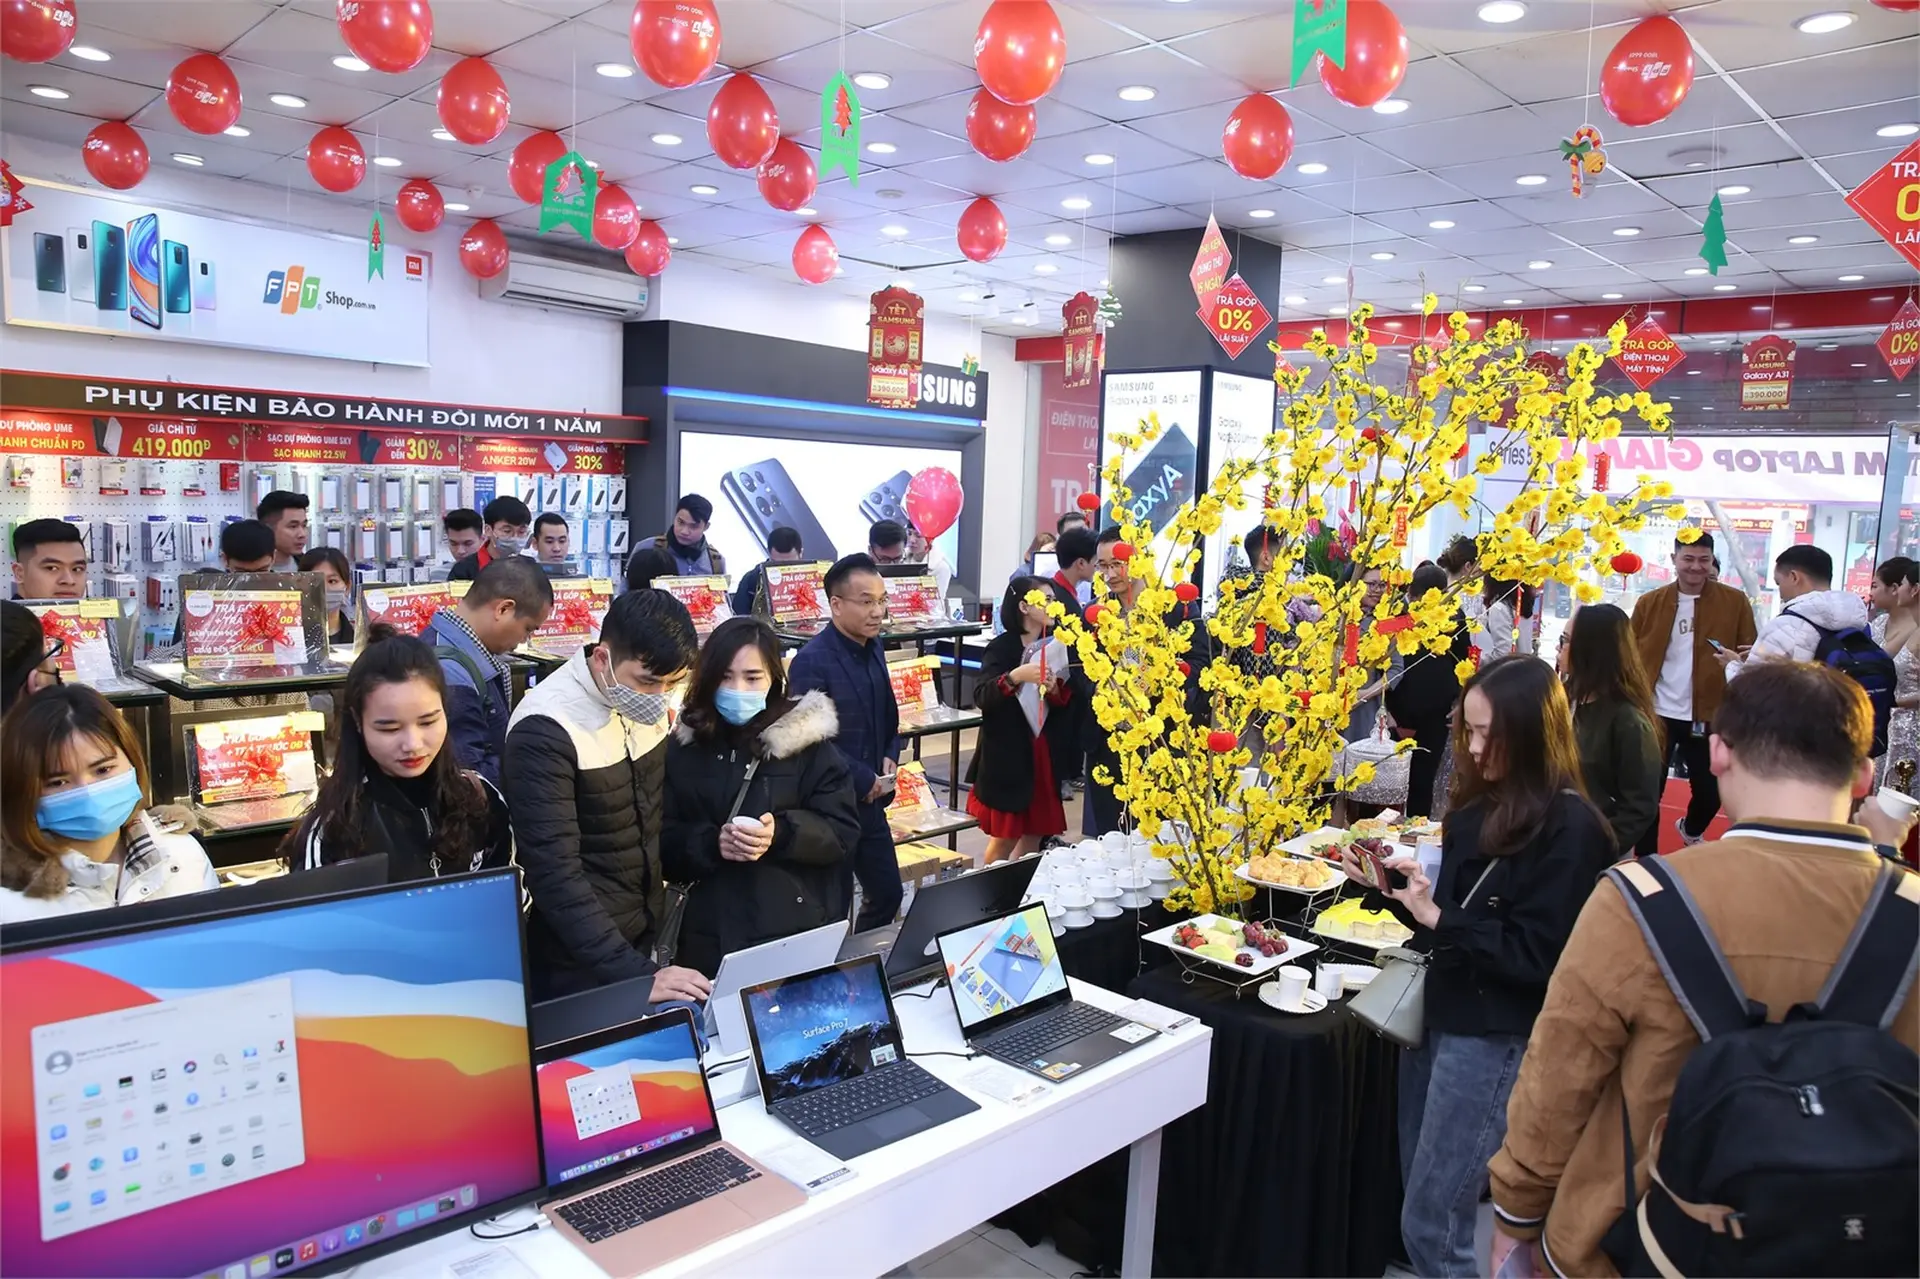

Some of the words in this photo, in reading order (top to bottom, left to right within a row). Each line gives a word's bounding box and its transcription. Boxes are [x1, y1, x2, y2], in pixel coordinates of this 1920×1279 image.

[1216, 293, 1234, 305] TRẢ
[1235, 294, 1257, 307] GÓP
[888, 304, 906, 315] TẾT
[878, 316, 915, 325] SAMSUNG
[1074, 311, 1087, 325] TẾT
[1218, 308, 1252, 332] 0%
[1068, 325, 1092, 337] SAMSUNG
[1219, 332, 1231, 343] LÃI
[1231, 332, 1249, 343] SUẤT
[1623, 338, 1645, 349] TRẢ
[1647, 339, 1674, 350] GÓP
[1890, 330, 1919, 354] 0%
[1623, 352, 1642, 363] ĐIỆN
[1644, 355, 1670, 364] THOẠI
[1759, 350, 1777, 360] TẾT
[872, 365, 896, 375] Galaxy
[1625, 363, 1643, 373] MÁY
[1646, 364, 1664, 373] TÍNH
[1743, 372, 1773, 380] Galaxy
[919, 373, 976, 408] SUNG
[1107, 381, 1154, 392] SAMSUNG
[85, 385, 164, 411] PHỤ
[177, 392, 256, 415] KIỆN
[268, 397, 336, 418] BẢO
[345, 403, 423, 423] HÀNH
[431, 409, 476, 427] ĐỔI
[484, 412, 529, 430] MỚI
[537, 419, 545, 431] 1
[554, 417, 601, 433] NĂM
[16, 420, 51, 432] PHÒNG
[54, 422, 73, 433] UME
[1051, 410, 1075, 431] ĐIỆN
[1078, 415, 1098, 430] THO
[148, 421, 165, 434] GIÁ
[167, 422, 183, 435] CHỈ
[184, 423, 197, 435] TỪ
[31, 434, 69, 450] CHUẨN
[72, 440, 85, 450] PD
[267, 433, 283, 444] SẠC
[284, 433, 295, 445] DỰ
[296, 432, 321, 445] PHÒNG
[323, 436, 338, 445] UME
[385, 437, 405, 448] GIẢM
[273, 448, 291, 460] SẠC
[292, 447, 321, 458] NHANH
[323, 449, 347, 459] 22.5W
[390, 448, 406, 459] ĐẾN
[406, 438, 443, 460] 30%
[482, 455, 517, 466] ANKER
[518, 456, 537, 466] 20W
[574, 455, 603, 470] 30%
[802, 1024, 831, 1039] Surface
[831, 1020, 844, 1031] Pro
[841, 1018, 848, 1029] 7
